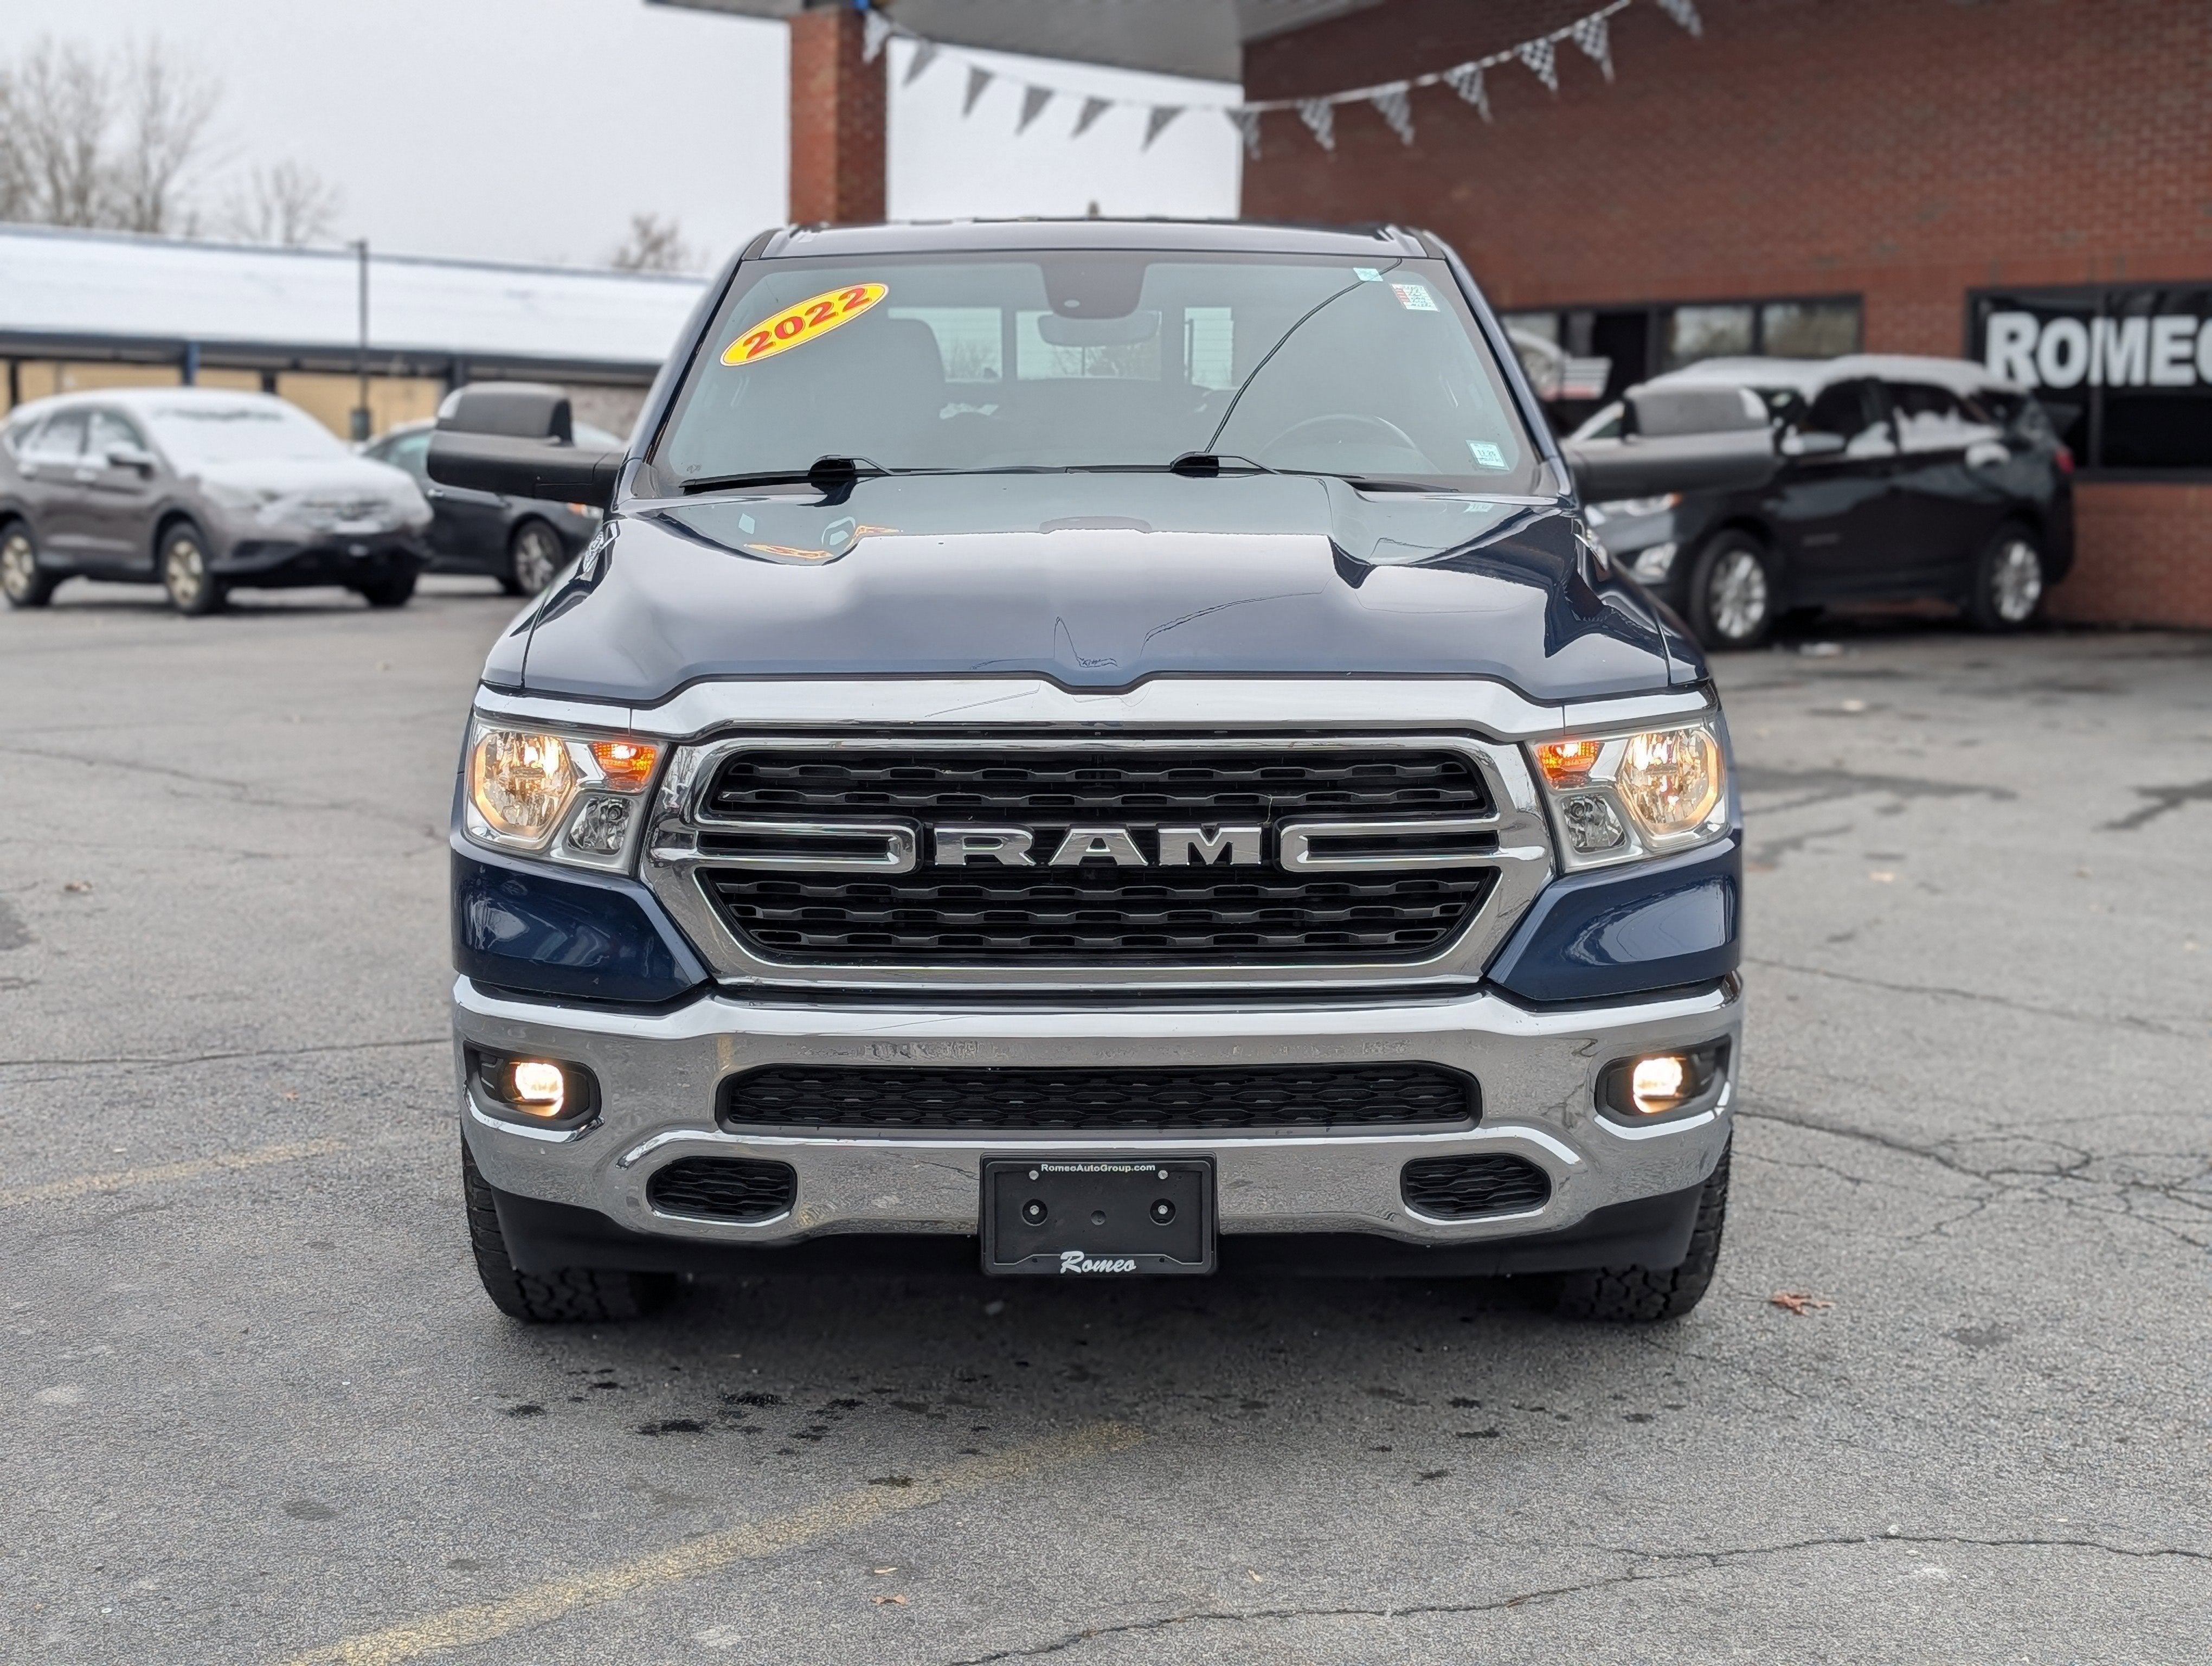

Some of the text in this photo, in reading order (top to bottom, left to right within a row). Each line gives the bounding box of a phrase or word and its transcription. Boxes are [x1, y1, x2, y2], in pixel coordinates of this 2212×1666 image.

[743, 287, 872, 359] 2022
[935, 825, 1262, 866] RAM
[1041, 1164, 1156, 1173] RomeoAutoGroup.com
[1060, 1251, 1137, 1274] Romeo
